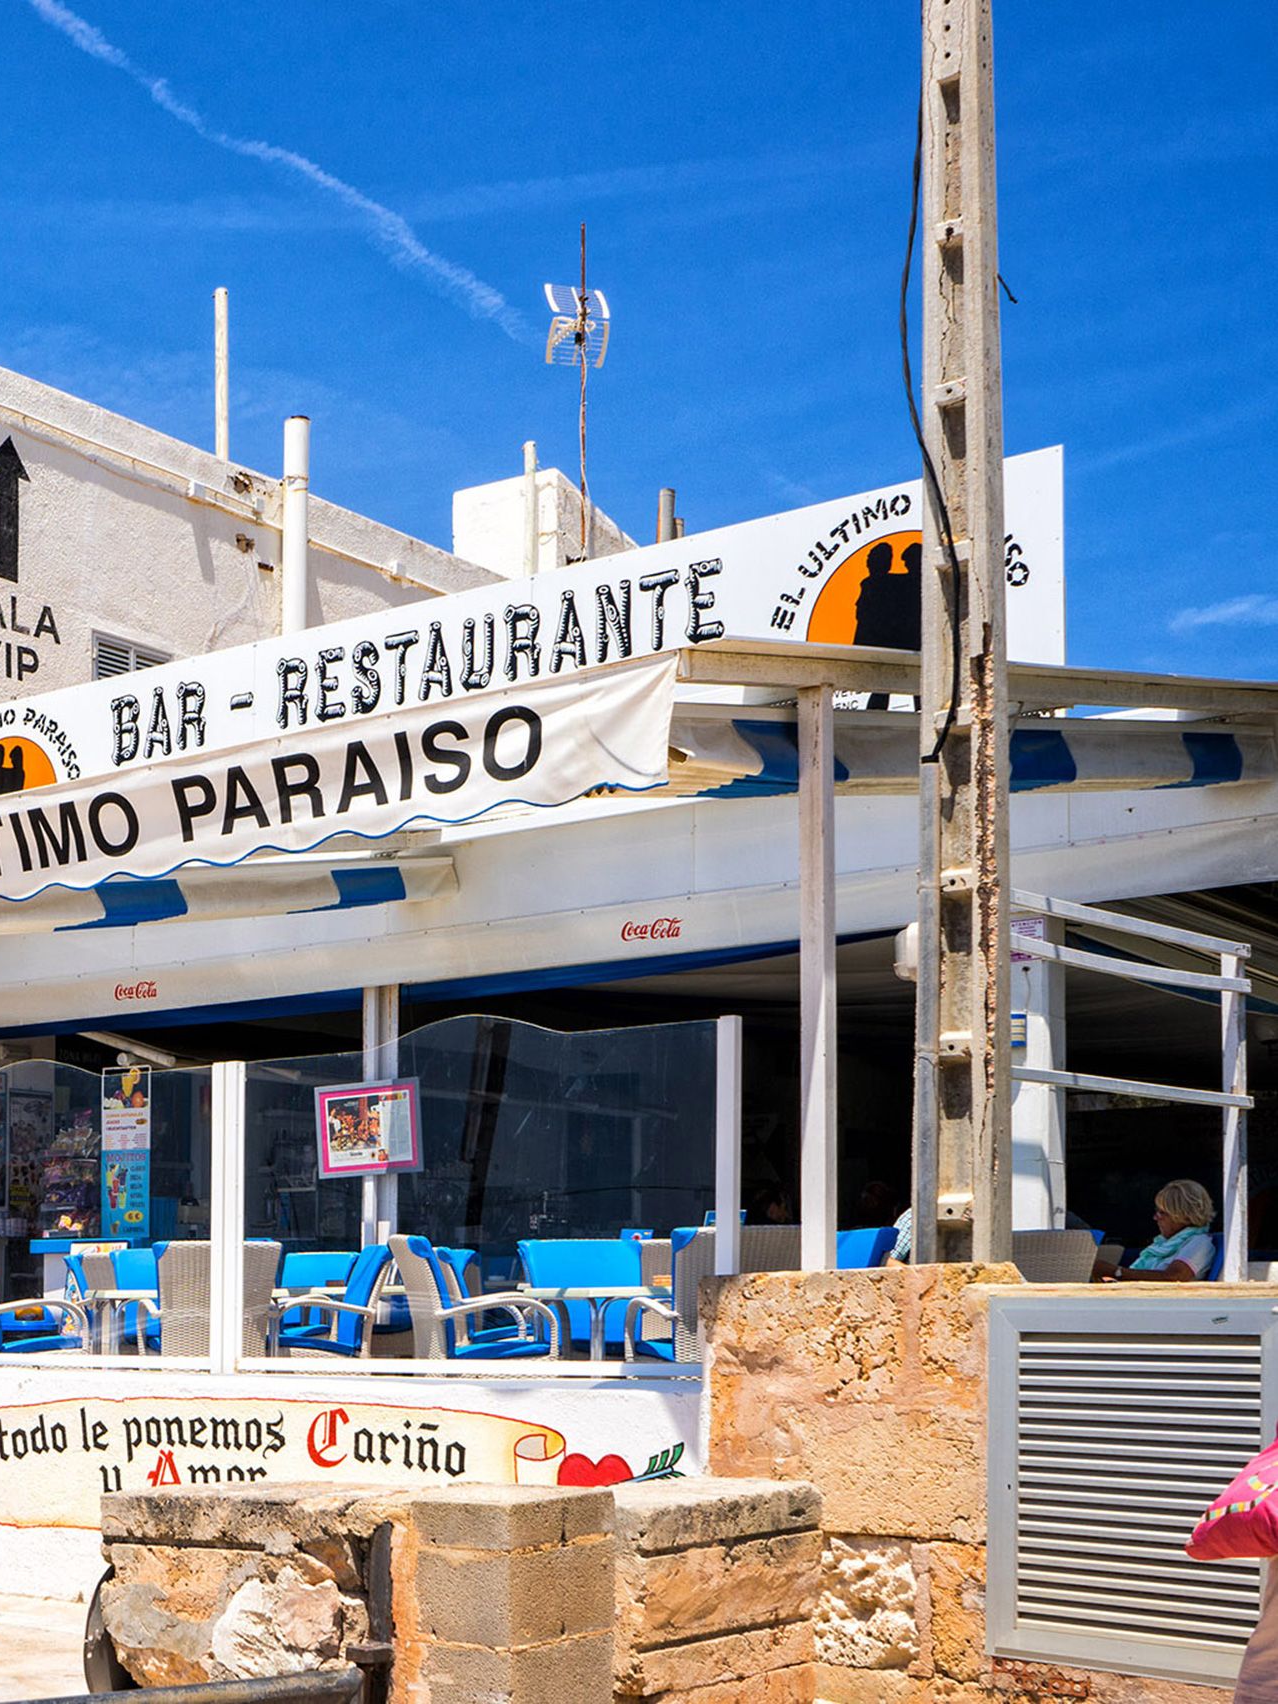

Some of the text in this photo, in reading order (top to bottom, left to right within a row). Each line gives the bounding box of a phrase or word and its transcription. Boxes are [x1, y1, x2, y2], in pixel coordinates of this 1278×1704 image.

[770, 494, 912, 631] EL ULTIMO
[110, 680, 206, 766] BAR
[275, 557, 725, 730] RESTAURANTE
[23, 707, 81, 780] PARAISO
[170, 705, 543, 844] PARAISO
[621, 917, 683, 942] Coca-Cola
[114, 980, 157, 1001] Coca-Cola
[81, 1408, 110, 1453] le
[123, 1411, 286, 1463] ponemos
[306, 1407, 467, 1479] Cariño
